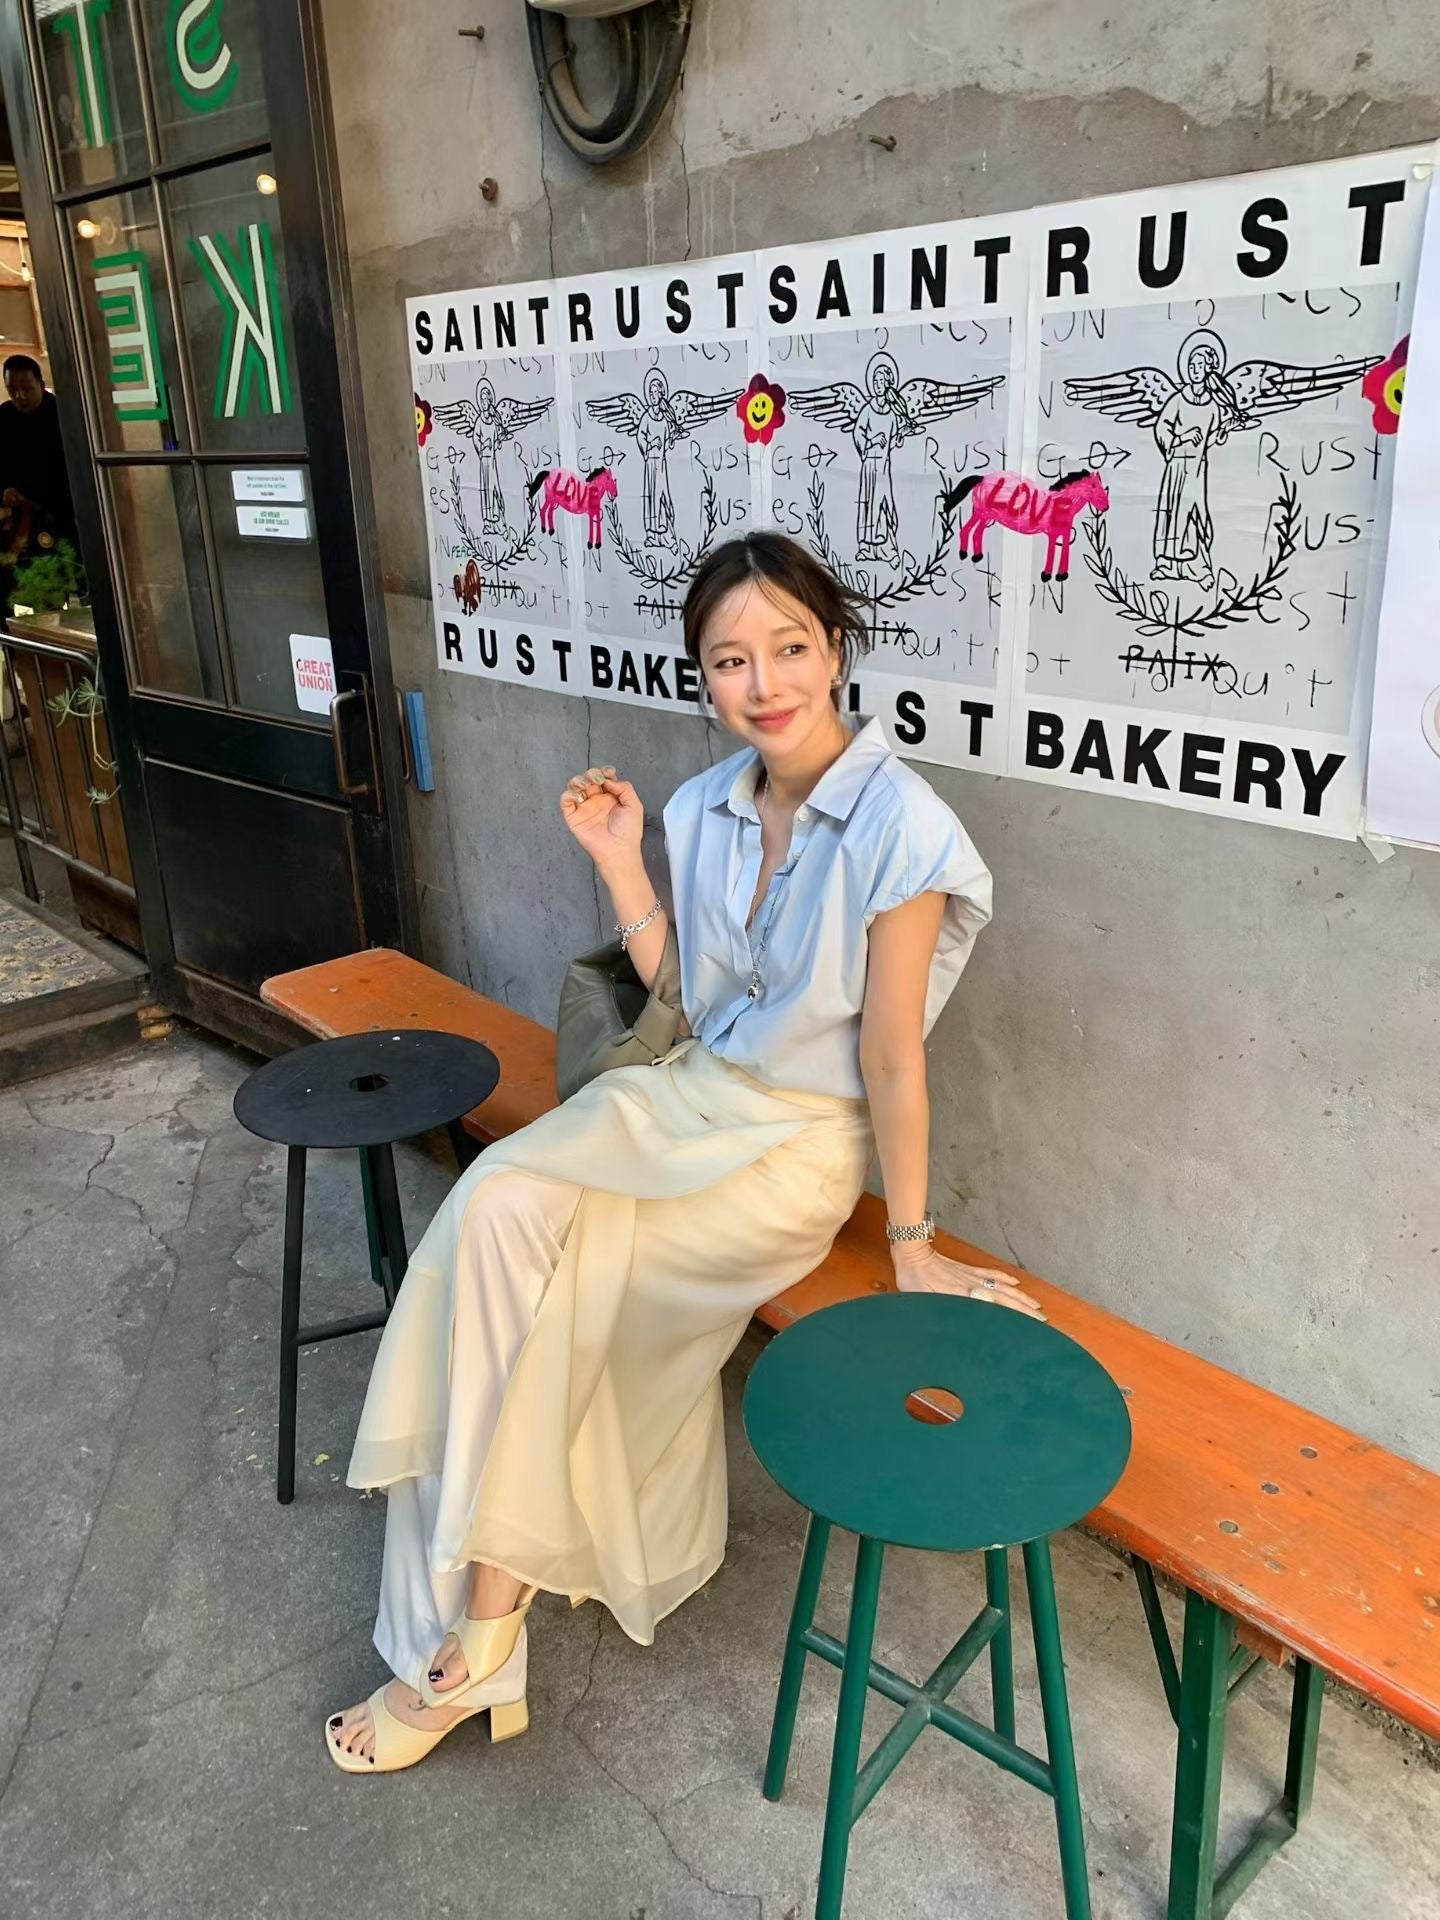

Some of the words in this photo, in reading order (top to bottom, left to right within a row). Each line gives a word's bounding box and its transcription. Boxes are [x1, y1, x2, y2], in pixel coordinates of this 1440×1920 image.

[415, 297, 549, 355] SAINT
[568, 272, 744, 343] RUST
[768, 235, 1011, 325] SAINT
[1046, 180, 1406, 298] RUST
[553, 472, 599, 505] LOVE
[985, 478, 1074, 525] LOVE
[298, 673, 333, 692] UNION
[443, 622, 572, 682] RUST
[590, 644, 714, 705] BAKE
[1025, 709, 1346, 818] BAKERY
